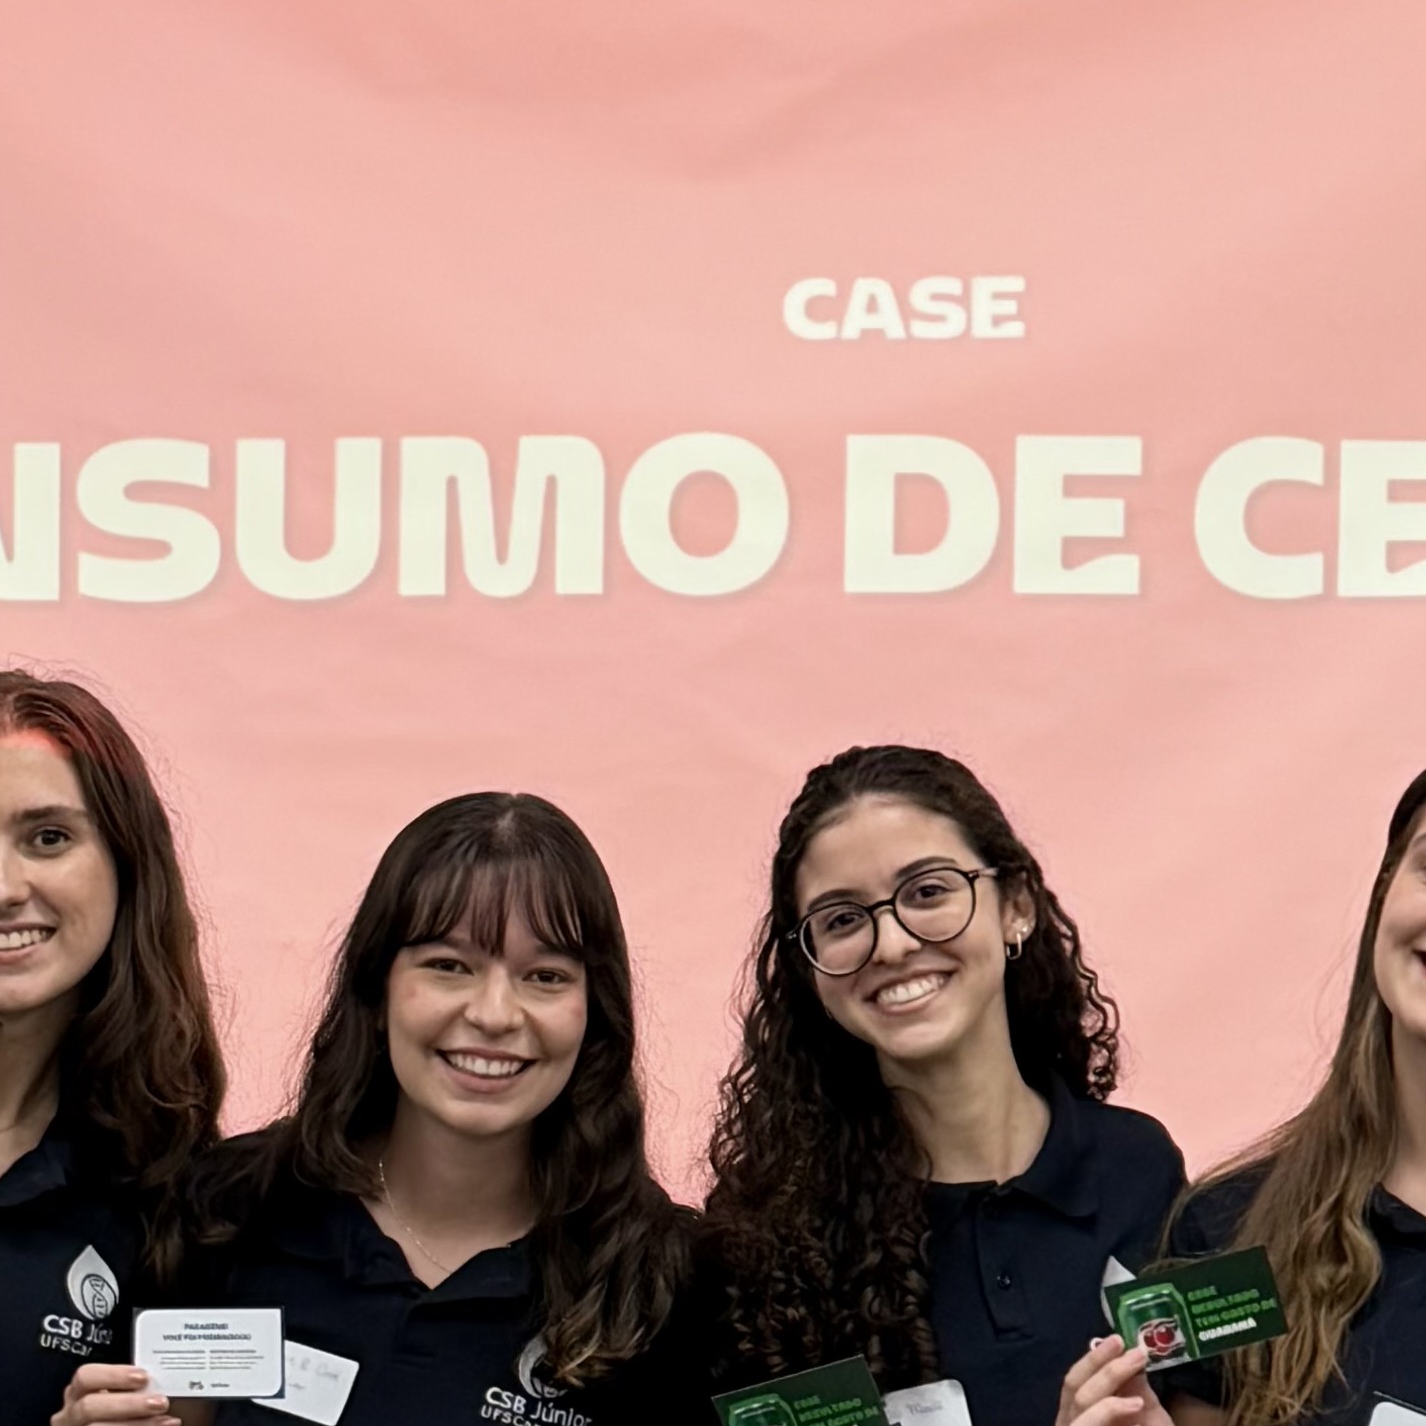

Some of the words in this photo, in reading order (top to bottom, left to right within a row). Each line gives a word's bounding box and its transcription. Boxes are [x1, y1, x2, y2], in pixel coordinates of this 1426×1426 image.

[782, 275, 1026, 342] CASE
[843, 434, 1143, 595] DE
[43, 1314, 83, 1339] CSB
[485, 1386, 527, 1415] CSB
